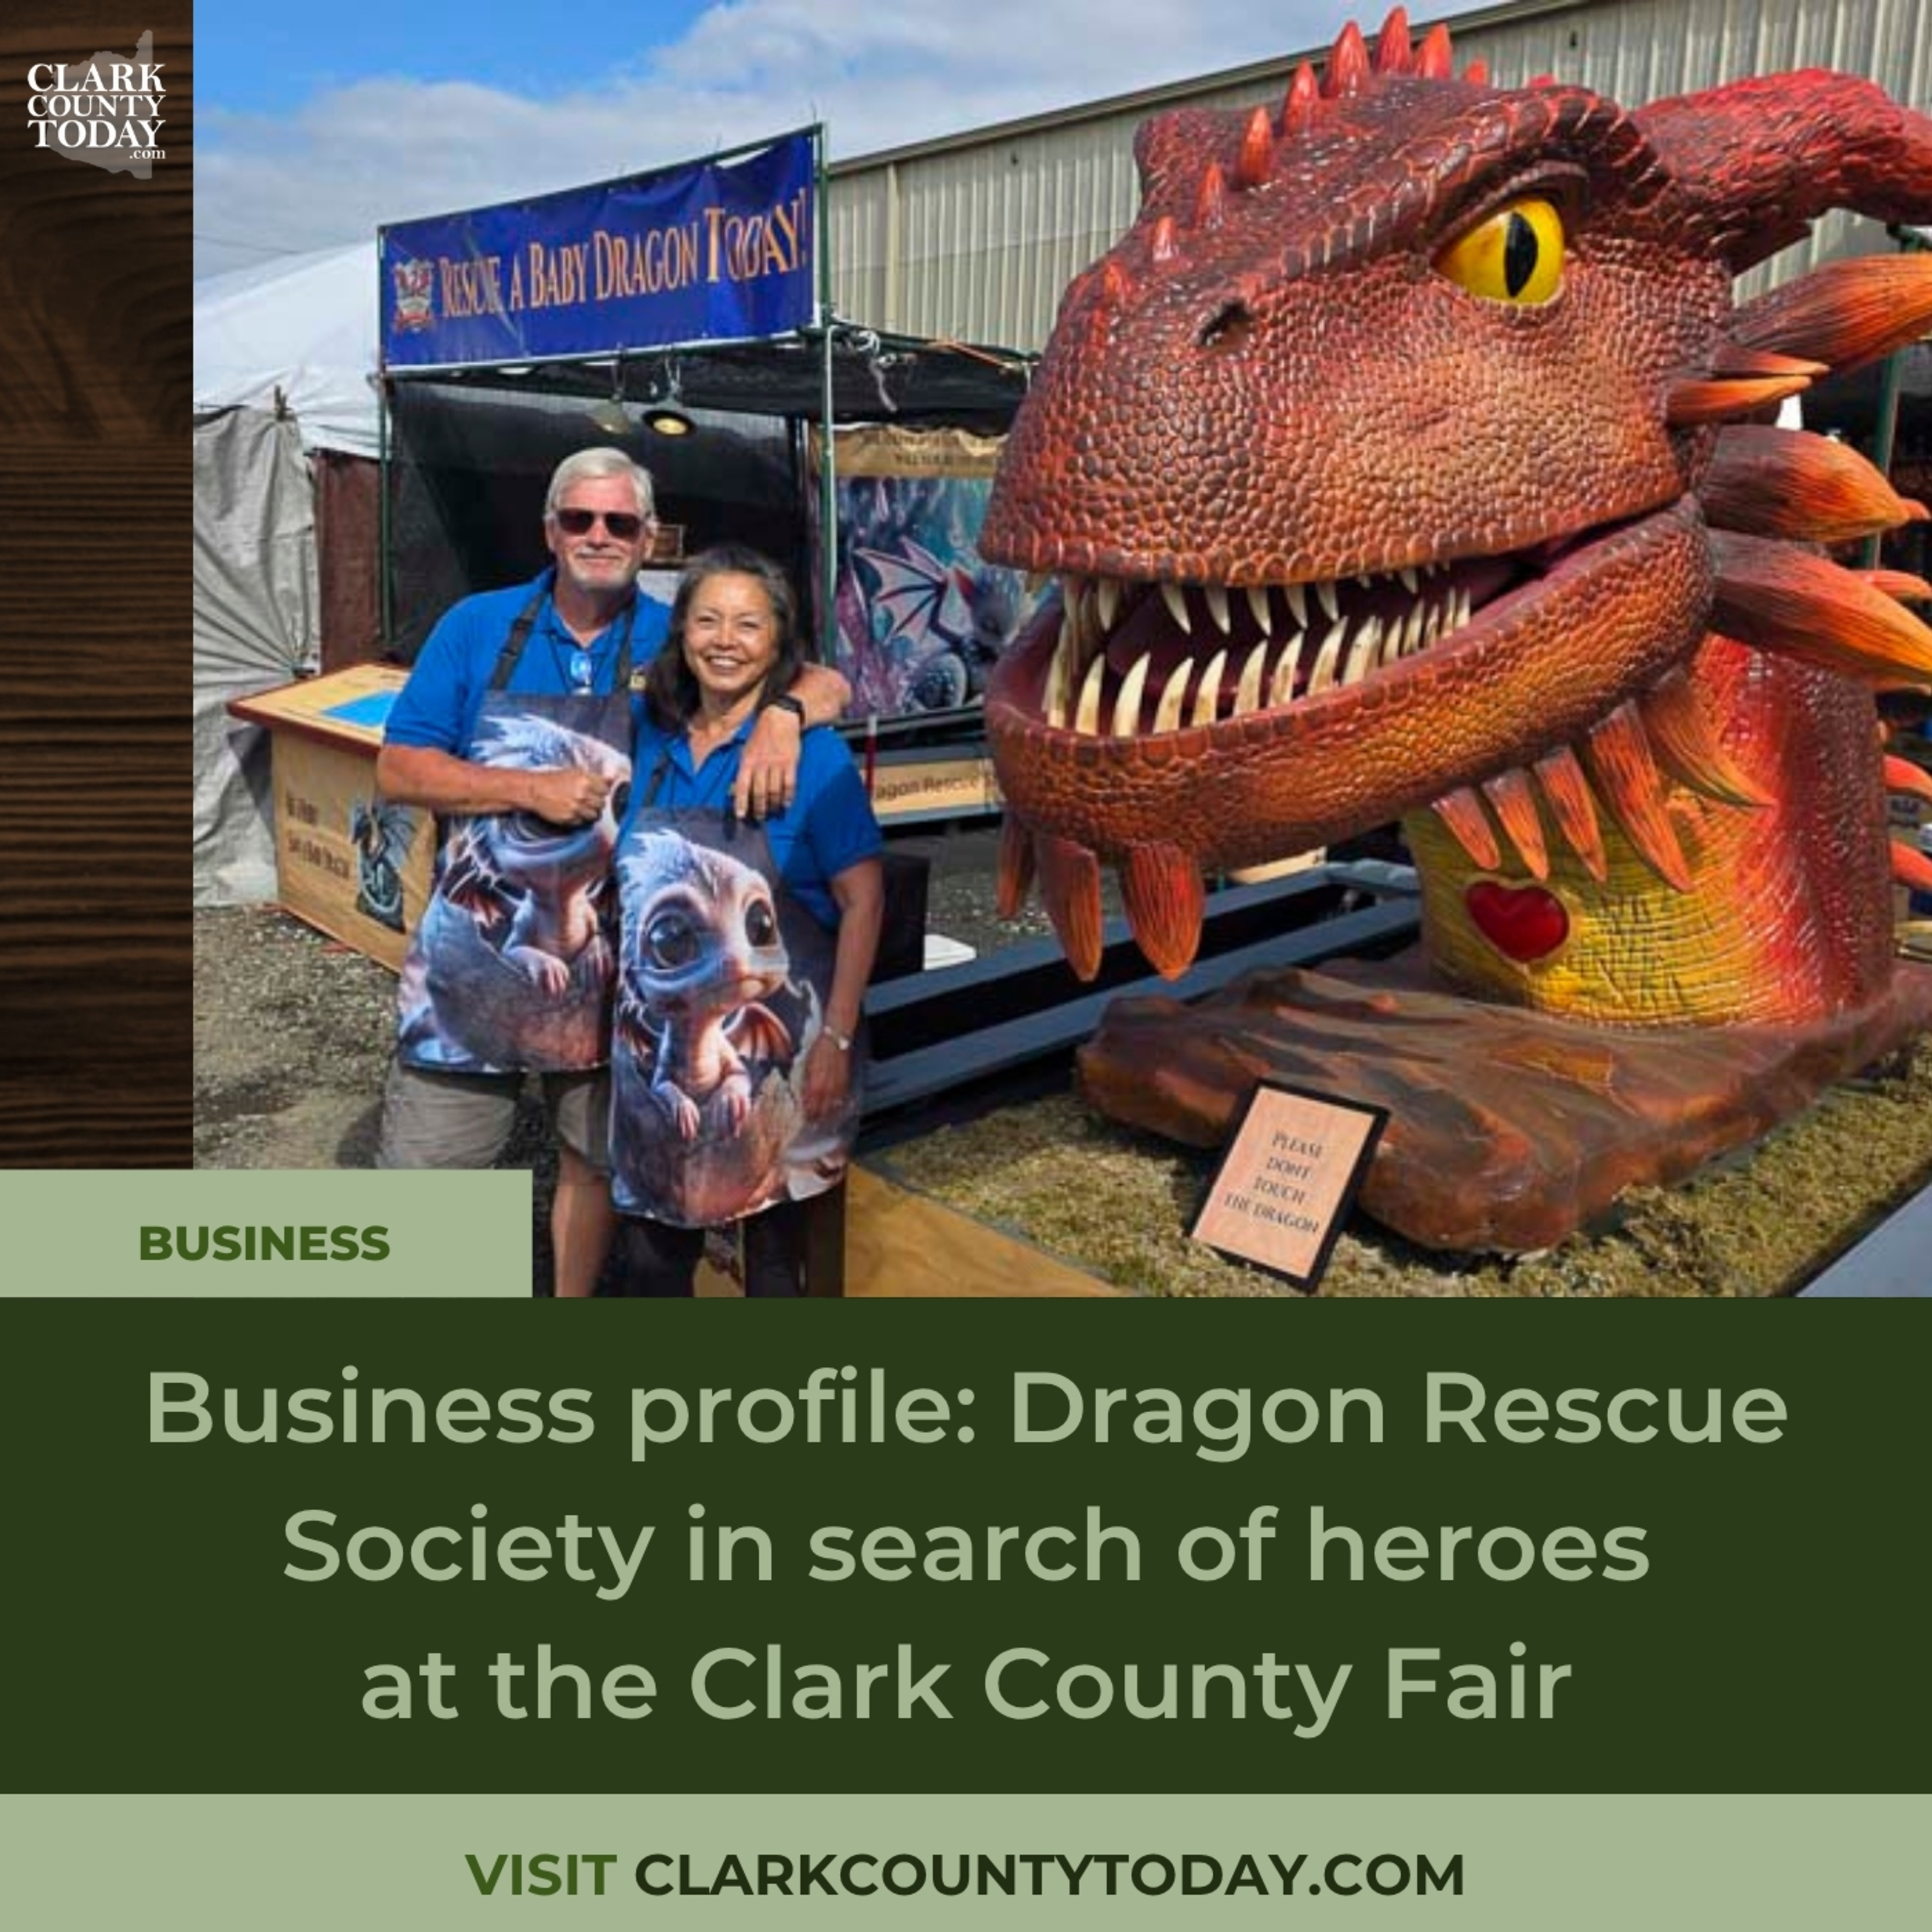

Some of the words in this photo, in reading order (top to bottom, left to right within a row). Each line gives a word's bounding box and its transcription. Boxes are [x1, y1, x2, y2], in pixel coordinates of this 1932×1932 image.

[511, 253, 524, 311] A
[530, 241, 589, 308] BABY
[593, 222, 698, 300] DRAGON
[704, 187, 806, 283] TODAY!
[876, 779, 920, 801] agon
[1272, 1130, 1322, 1158] PLEASE
[1253, 1175, 1305, 1206] TOUCH
[1224, 1193, 1250, 1211] THE
[1253, 1202, 1320, 1233] DRAGON
